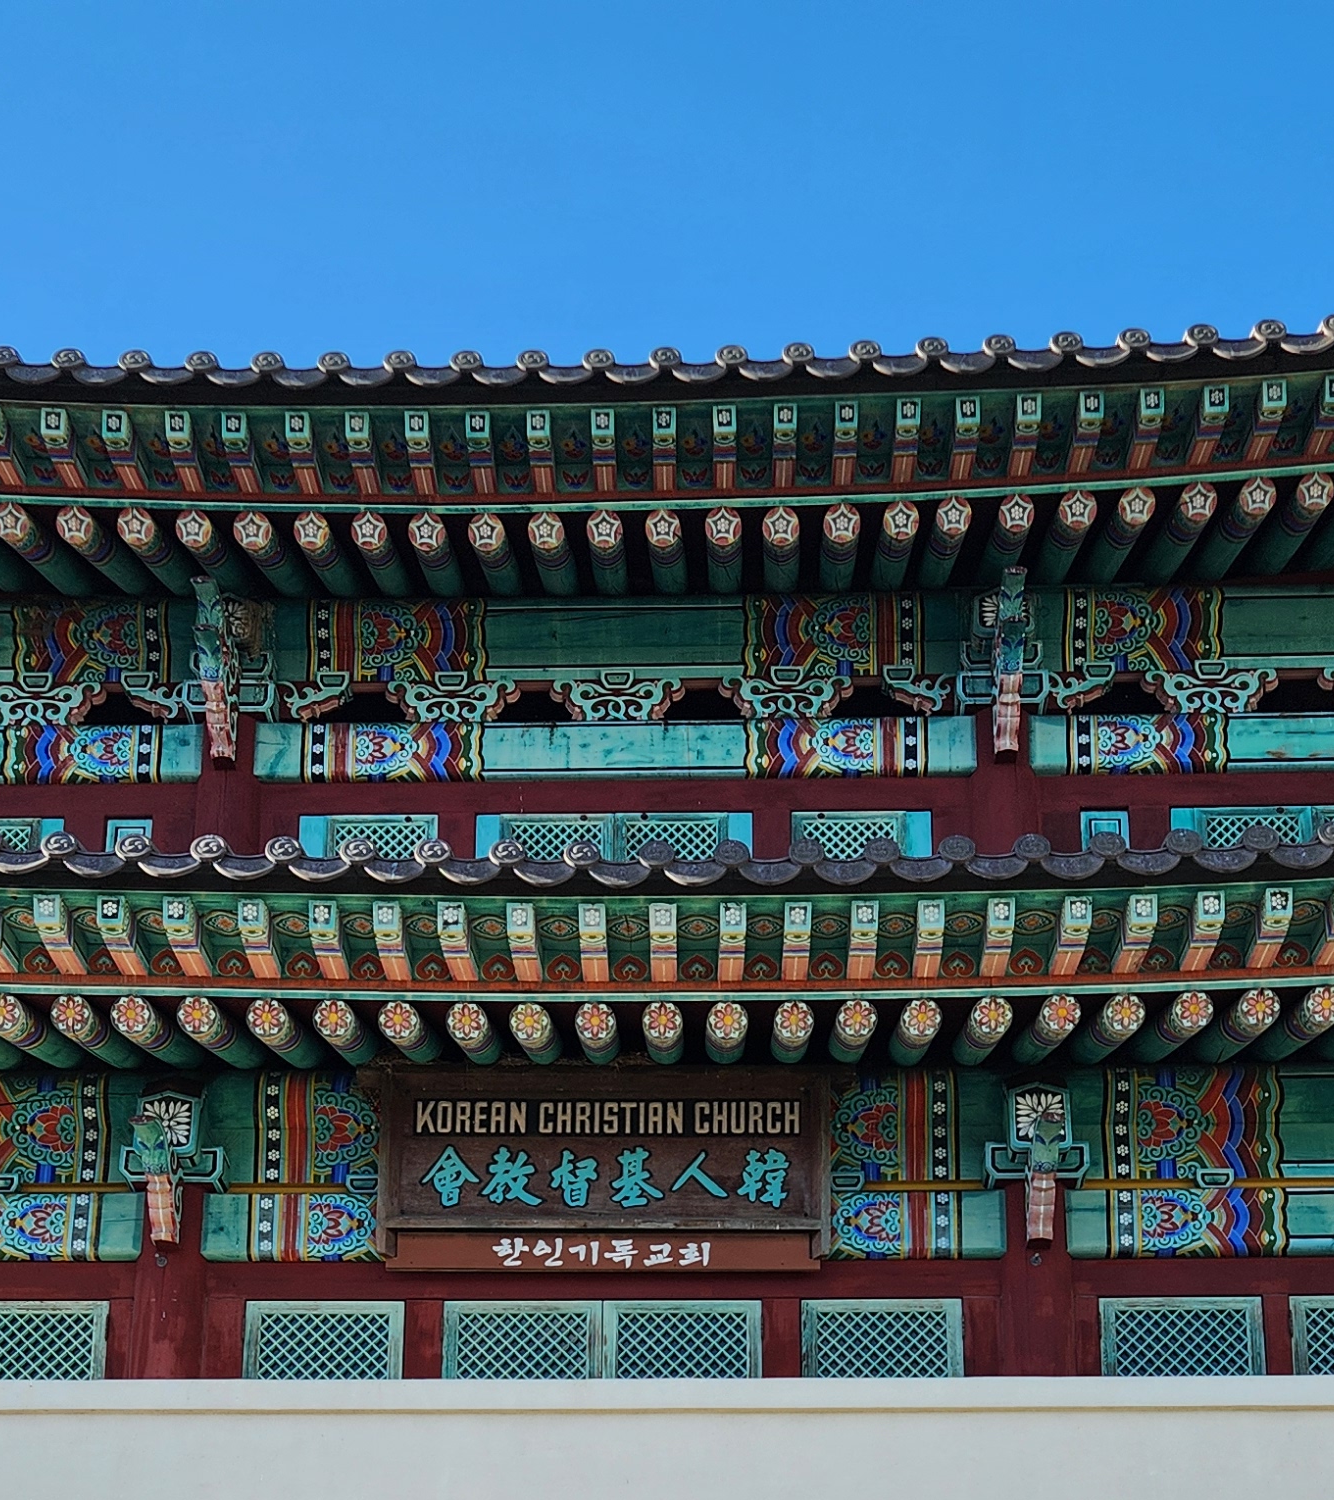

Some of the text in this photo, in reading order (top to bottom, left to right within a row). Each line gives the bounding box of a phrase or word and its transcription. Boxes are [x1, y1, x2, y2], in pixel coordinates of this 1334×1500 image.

[415, 1100, 801, 1134] KOREAN CHRISTIAN CHURCH
[492, 1236, 710, 1269] 한인기독교회
